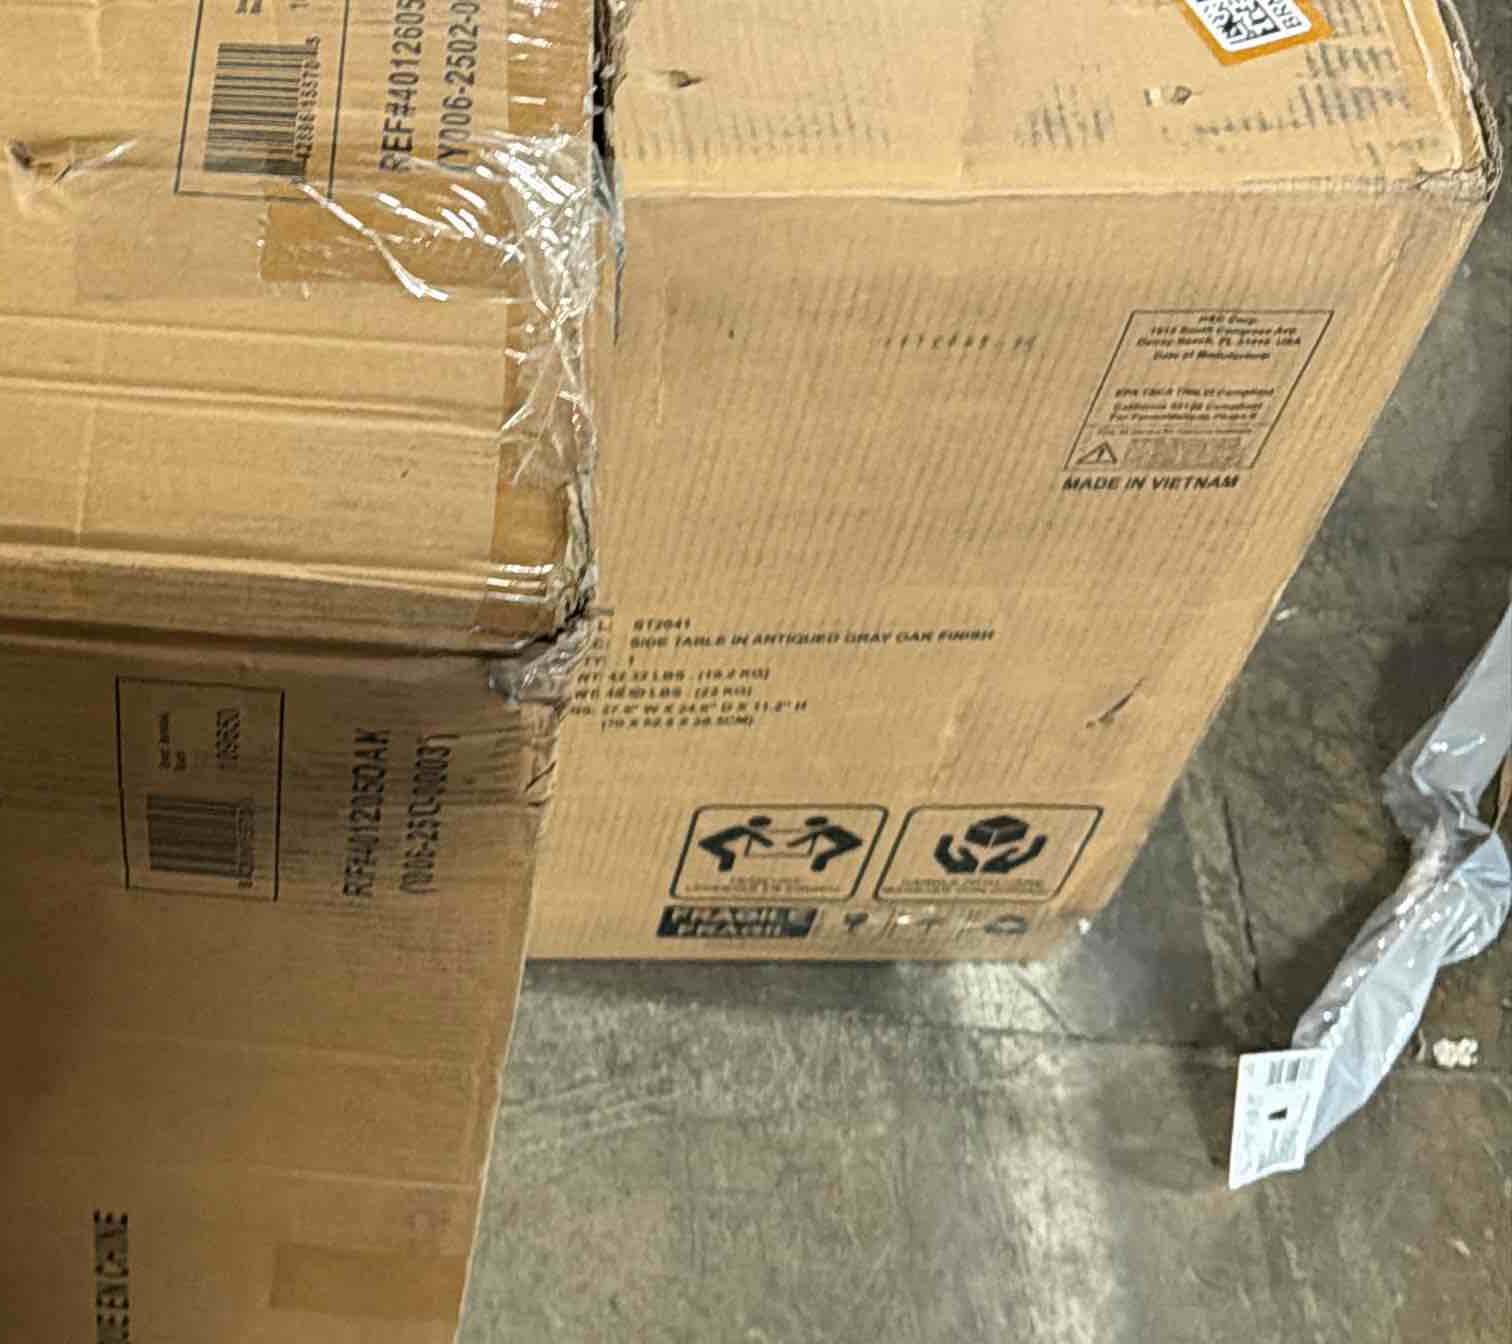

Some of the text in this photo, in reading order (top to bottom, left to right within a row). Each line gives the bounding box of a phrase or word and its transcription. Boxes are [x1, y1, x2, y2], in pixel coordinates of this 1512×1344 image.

[1062, 475, 1241, 491] MADE IN VIETNAM
